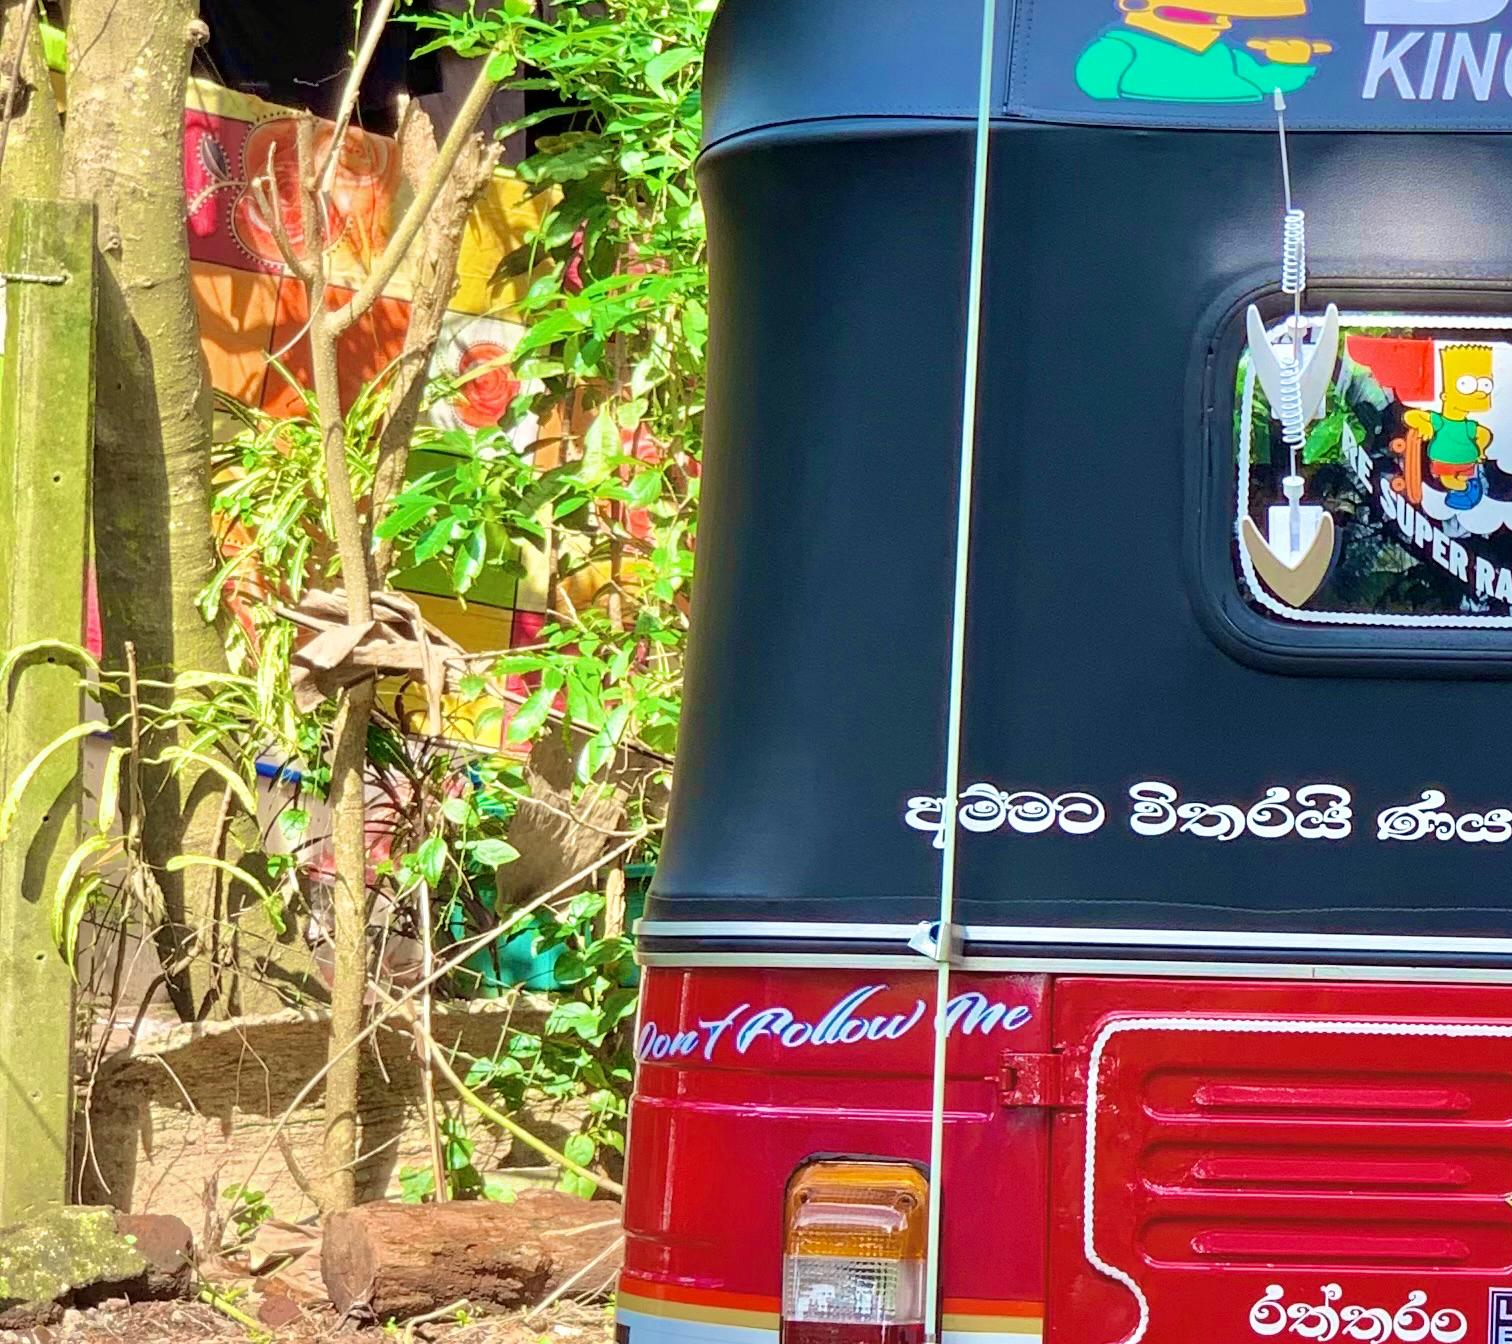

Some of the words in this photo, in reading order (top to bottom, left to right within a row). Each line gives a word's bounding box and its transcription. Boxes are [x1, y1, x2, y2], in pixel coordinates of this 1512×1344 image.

[1379, 477, 1469, 583] SUPER
[1129, 780, 1352, 842] විතරයි
[1377, 789, 1512, 843] ණය
[934, 991, 1032, 1038] Me
